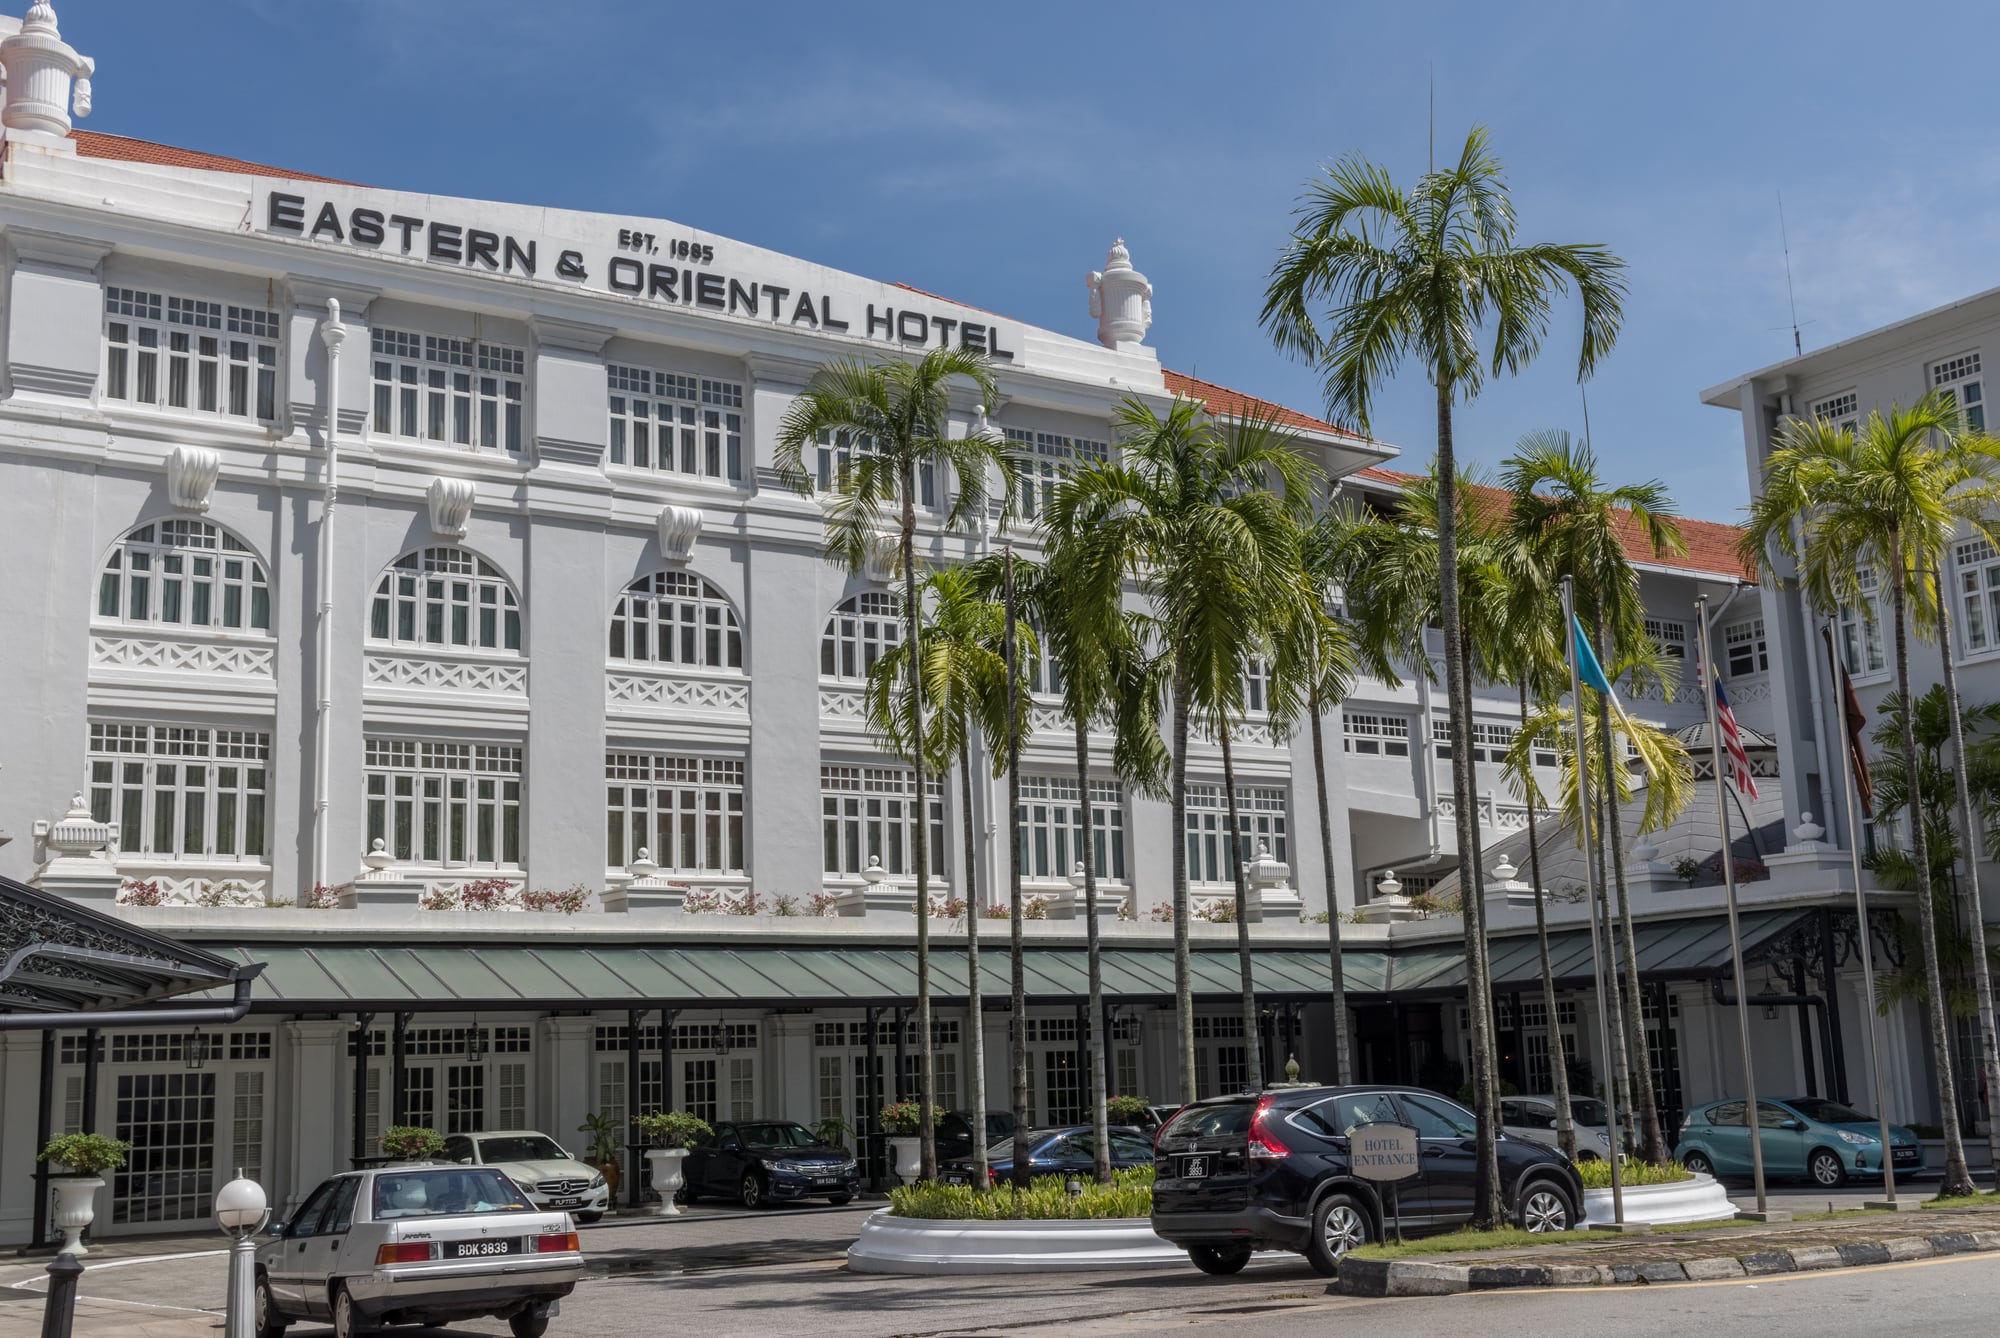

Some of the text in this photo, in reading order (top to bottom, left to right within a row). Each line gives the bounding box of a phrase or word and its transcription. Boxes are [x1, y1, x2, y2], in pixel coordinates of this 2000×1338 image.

[671, 238, 714, 261] 1885
[270, 191, 1014, 359] EASTERN & ORIENTAL HOTEL
[1365, 1139, 1403, 1151] HOTEL
[1354, 1153, 1416, 1166] ENTRANCE
[458, 1241, 508, 1256] BDK 3839
